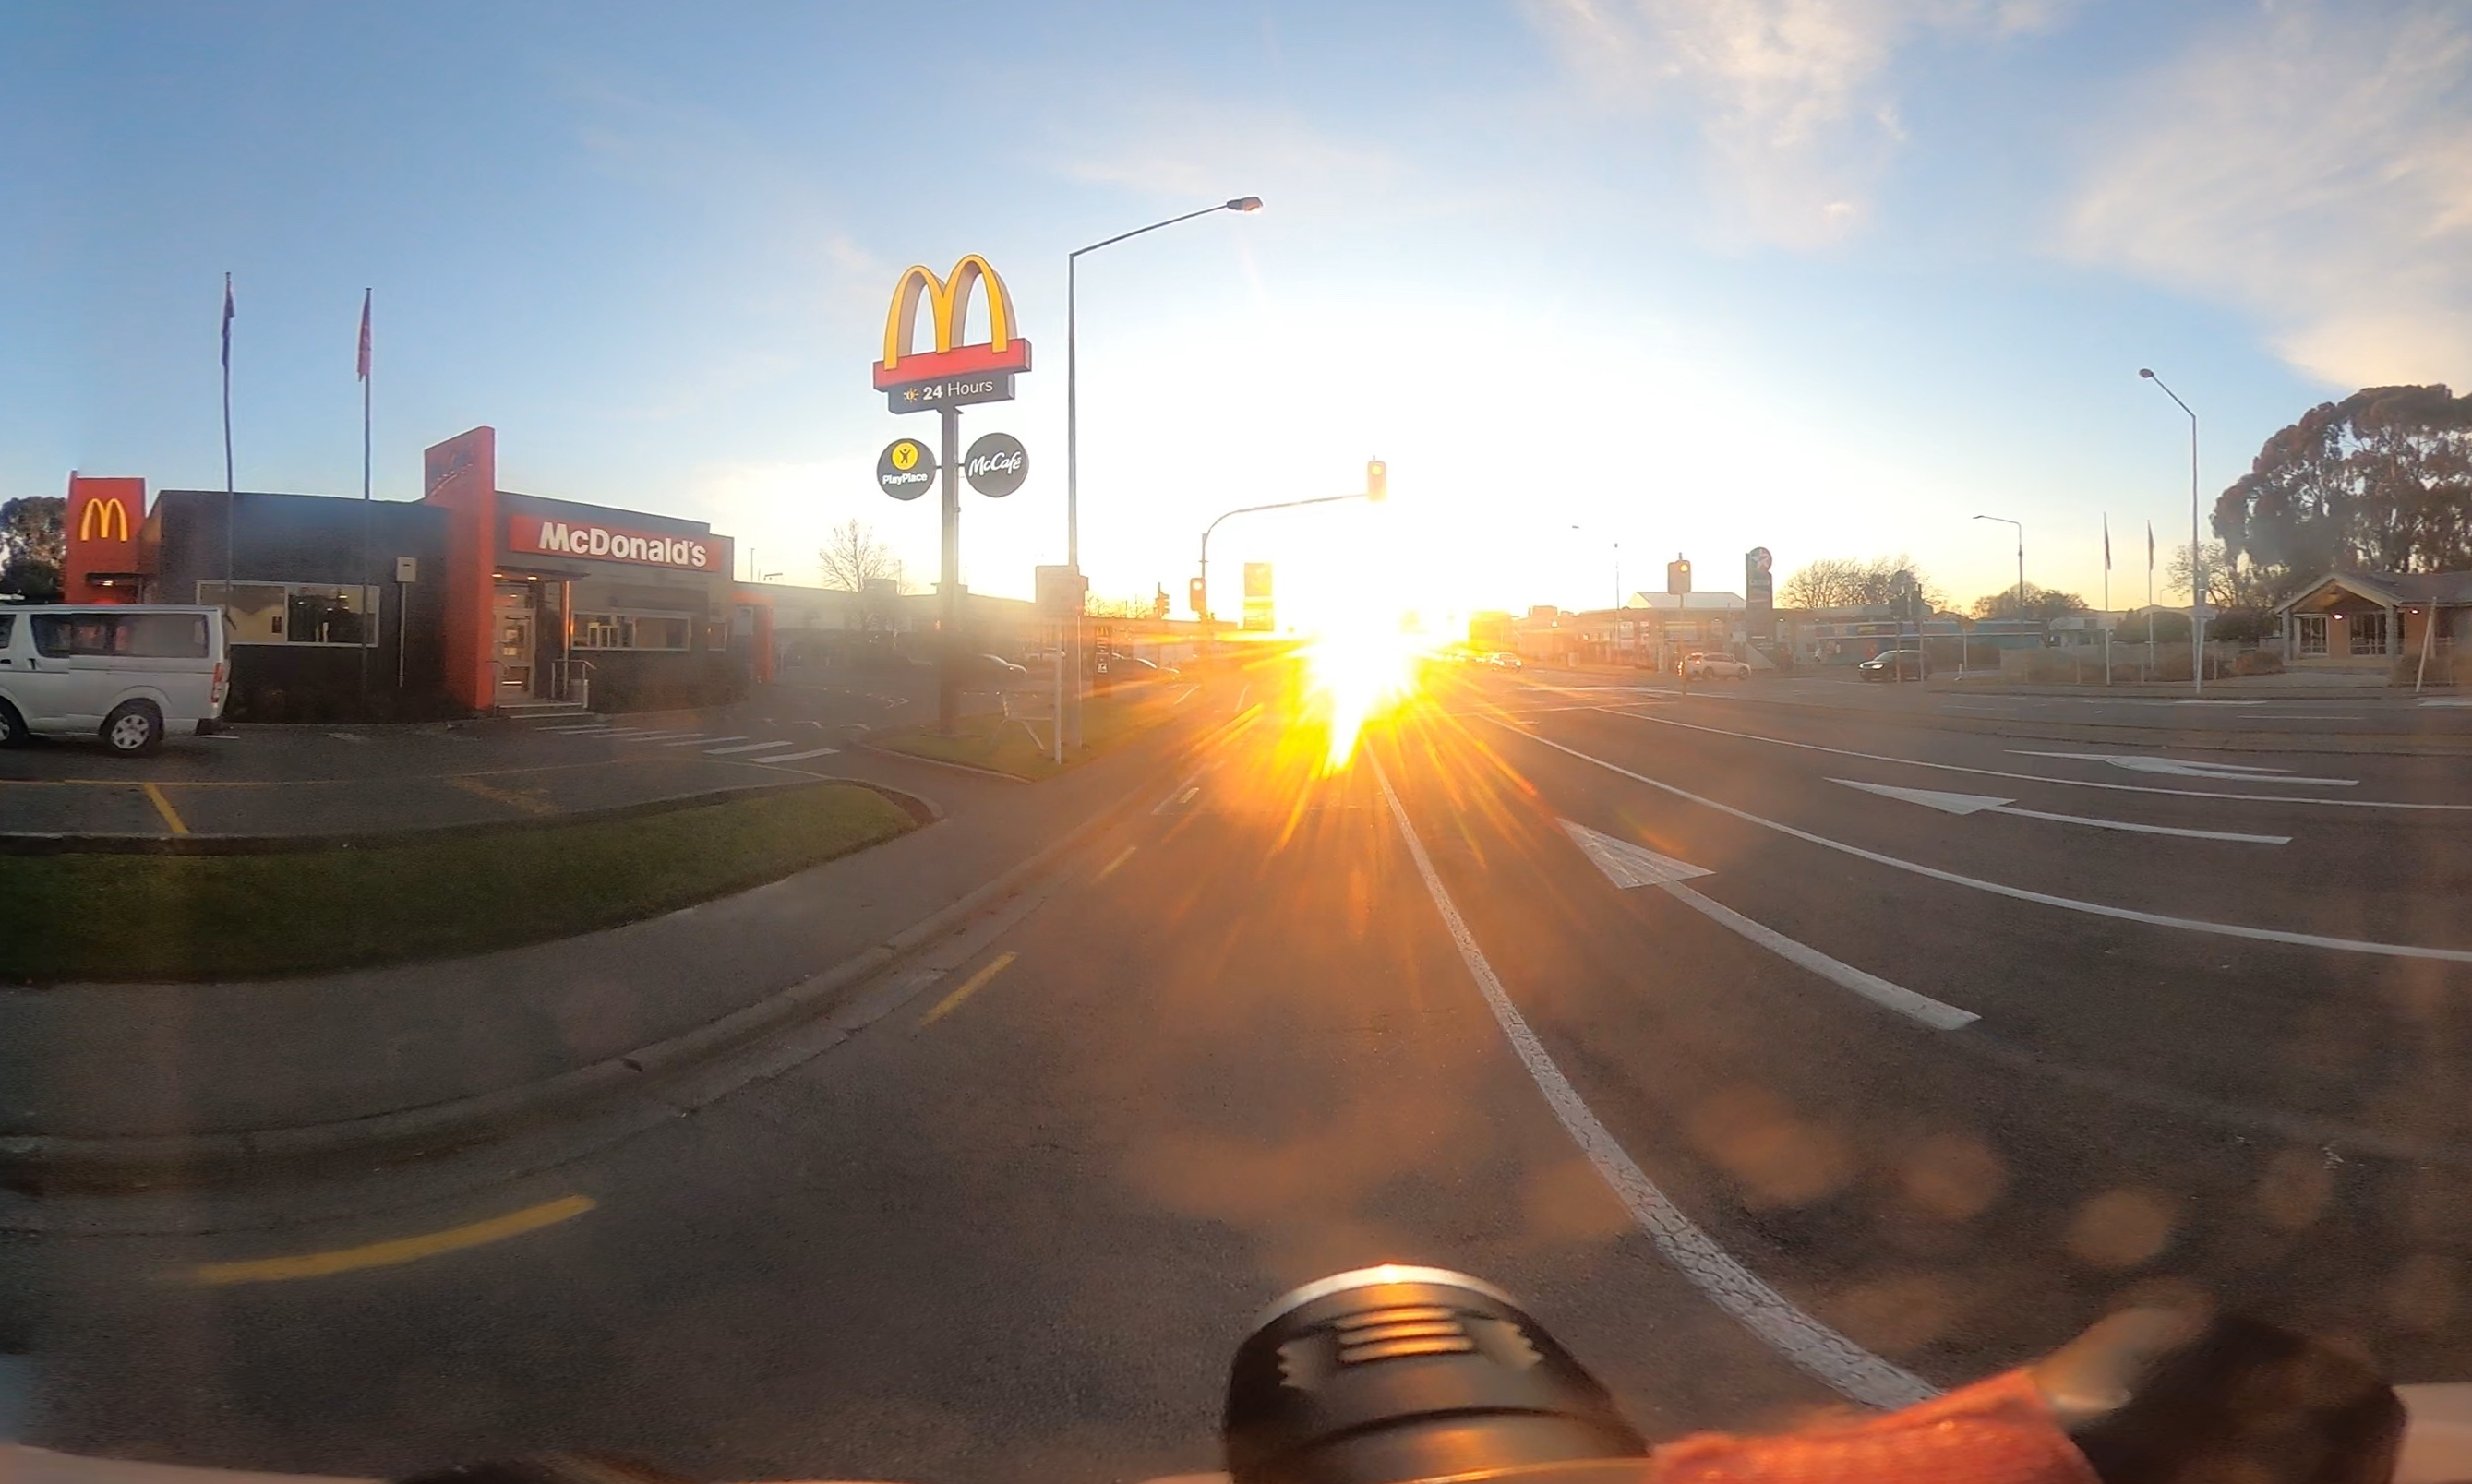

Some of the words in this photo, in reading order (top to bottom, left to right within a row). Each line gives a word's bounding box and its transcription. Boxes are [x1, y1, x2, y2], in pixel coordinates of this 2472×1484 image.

[923, 385, 943, 400] 24
[947, 380, 994, 397] Hours
[968, 451, 1022, 477] McCafé
[882, 472, 929, 485] PlayPlace
[538, 521, 708, 567] McDonald's
